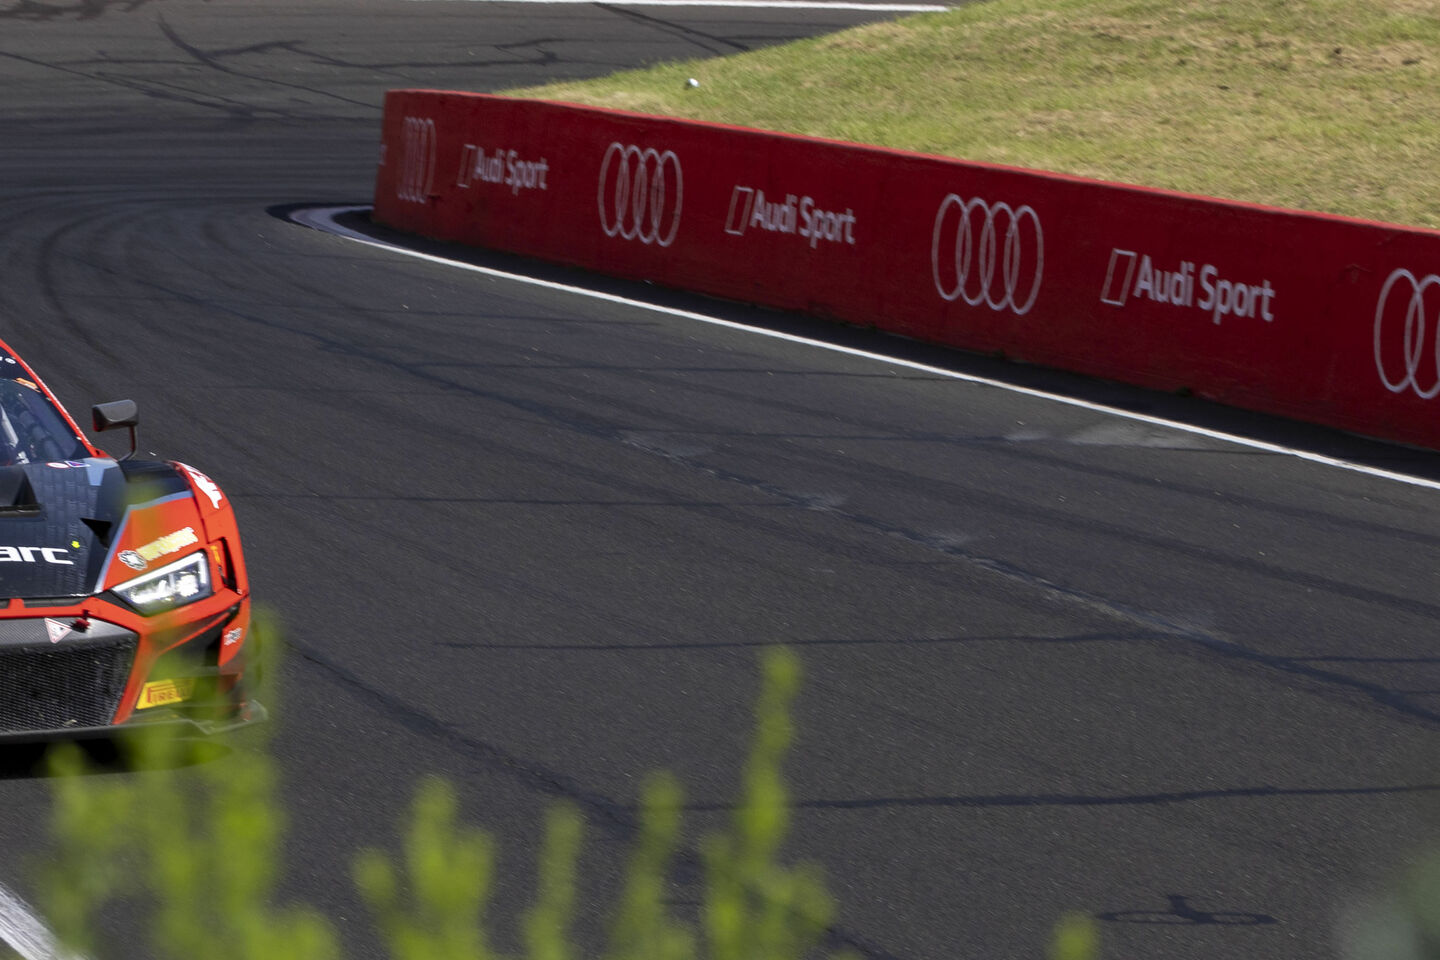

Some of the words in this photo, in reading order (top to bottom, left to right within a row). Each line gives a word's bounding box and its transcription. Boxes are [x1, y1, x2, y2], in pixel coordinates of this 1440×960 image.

[472, 146, 505, 183] Audi
[505, 149, 550, 196] Sport
[750, 189, 798, 234] Audi
[799, 195, 857, 250] Sport
[1133, 254, 1195, 307] Audi
[1197, 263, 1276, 326] Sport
